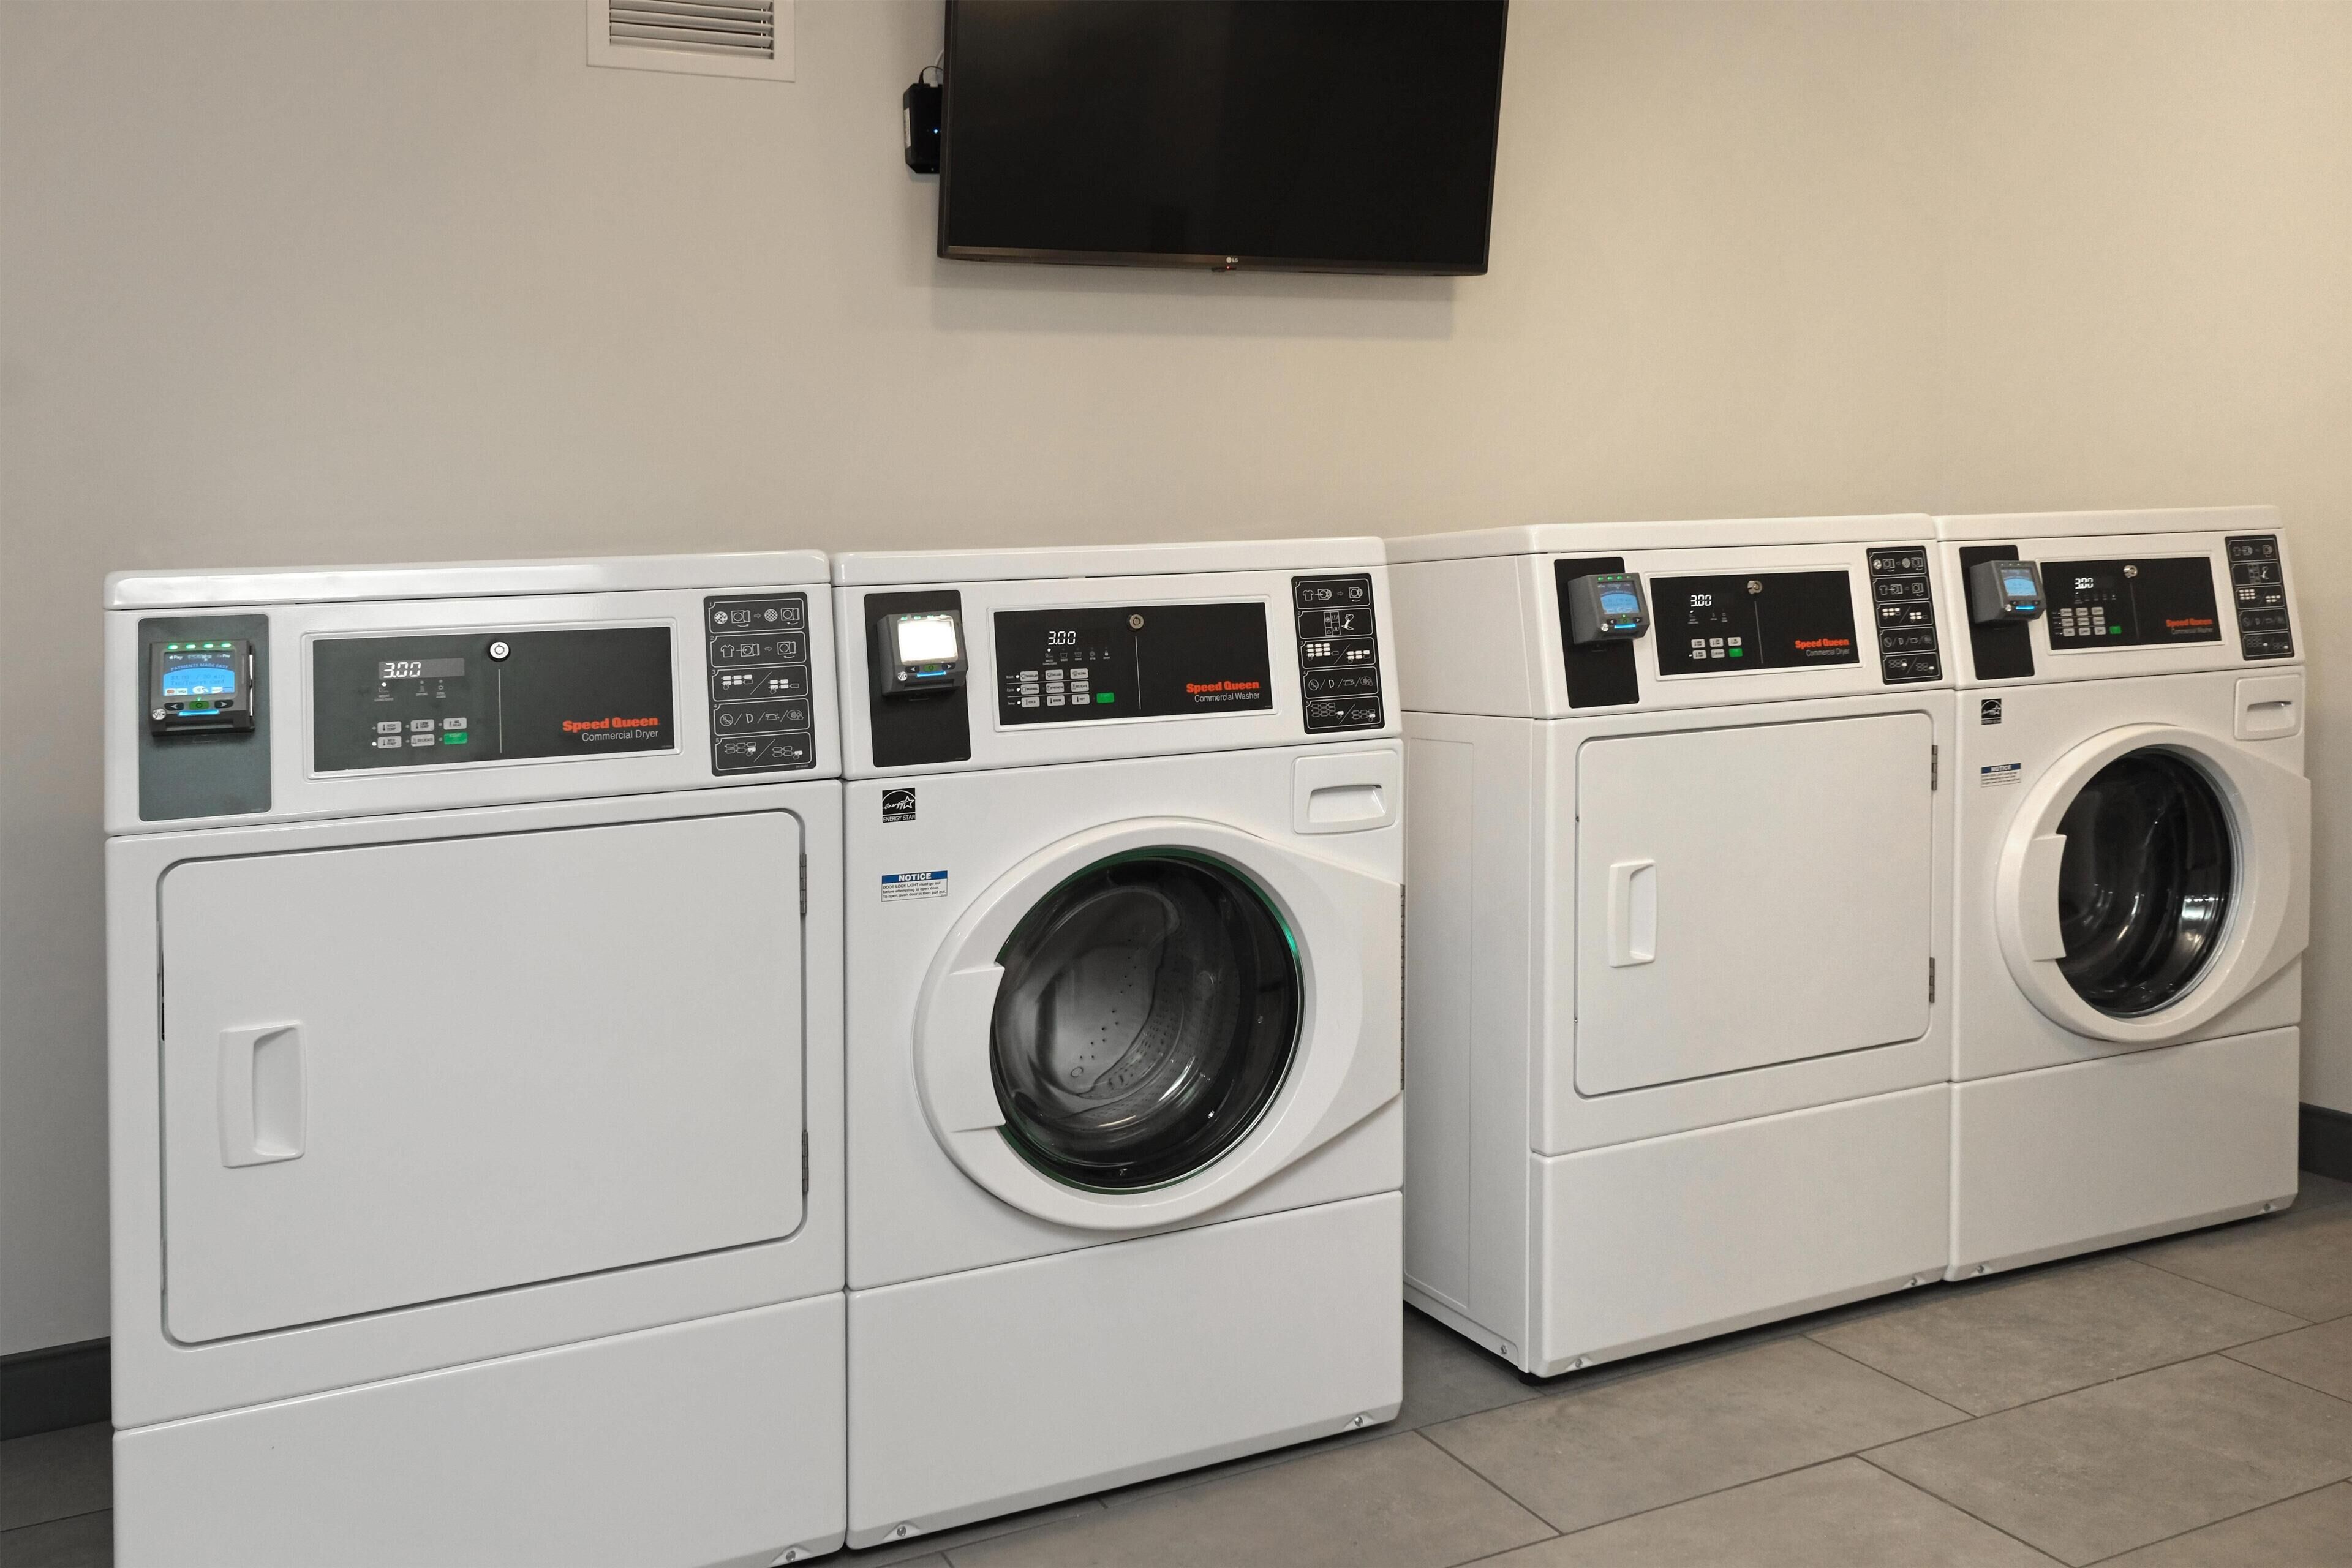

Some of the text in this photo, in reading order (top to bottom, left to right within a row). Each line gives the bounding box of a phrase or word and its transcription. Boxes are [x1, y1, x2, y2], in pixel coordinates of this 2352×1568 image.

[1795, 638, 1849, 649] Speed Queen
[383, 662, 421, 678] 3.00
[1186, 681, 1259, 694] Speed Queen
[1194, 693, 1234, 702] Commercial
[562, 717, 658, 733] Speed Queen
[582, 729, 658, 742] Commercial Dryer
[898, 873, 932, 882] NOTICE
